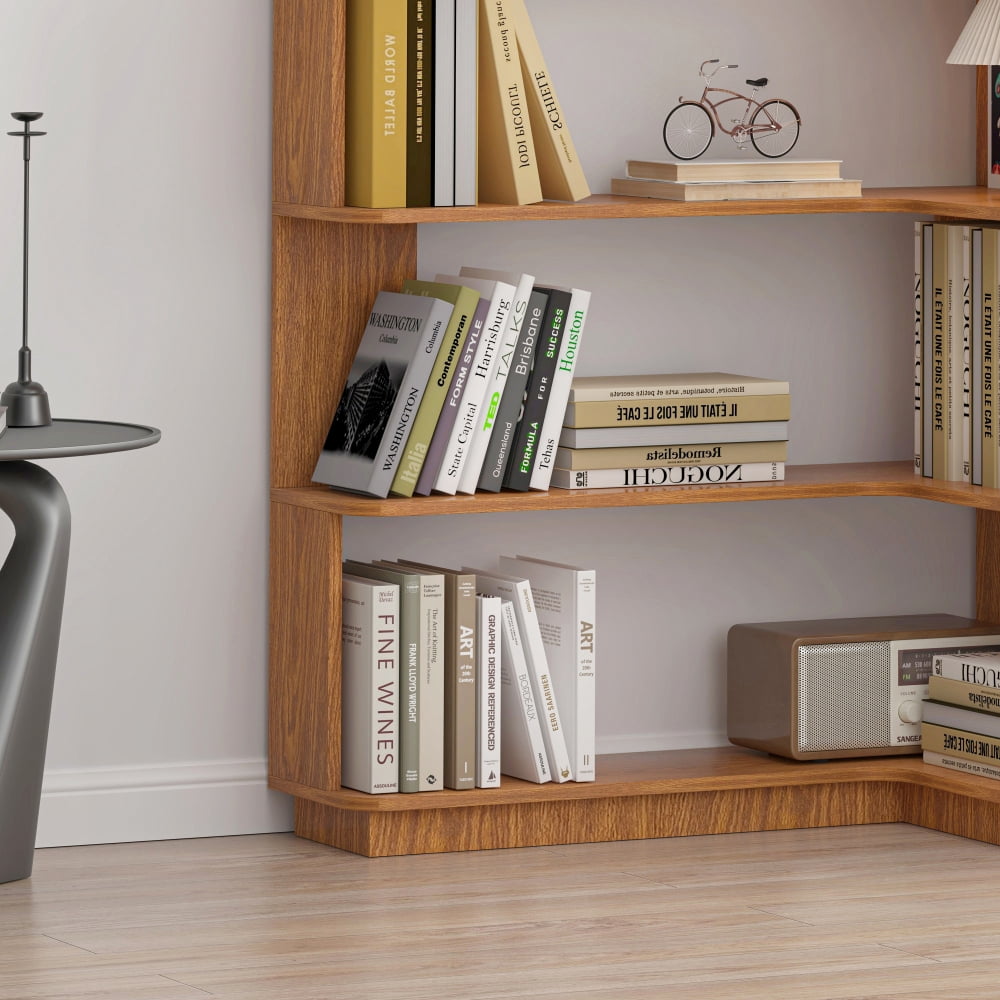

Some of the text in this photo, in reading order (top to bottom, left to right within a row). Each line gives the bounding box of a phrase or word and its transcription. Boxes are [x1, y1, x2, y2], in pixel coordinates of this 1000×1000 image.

[369, 312, 423, 333] WASHINGTON
[935, 288, 943, 298] IL
[449, 319, 483, 407] FORM STYLE
[483, 300, 527, 432] TED TALKS
[935, 335, 943, 356] UNE
[935, 360, 943, 382] FOIS
[382, 320, 442, 472] WASHINGTON Columbia
[400, 314, 468, 484] Italia Contemporan
[448, 298, 511, 478] State Capital Harrisburg
[492, 307, 542, 479] Queensland Brisbane
[519, 308, 564, 474] FORMULA FOR SUCCESS
[539, 310, 584, 470] Tehas Houston
[935, 387, 943, 399] LE
[935, 404, 943, 431] CAFÉ
[377, 614, 395, 670] FINE
[459, 625, 474, 659] ART
[580, 621, 593, 653] ART
[408, 643, 417, 723] FRANK LLOYD WRIGHT
[487, 614, 496, 751] GRAPHIC DESIGN REFERENCED
[518, 673, 536, 721] BORDEAUX
[540, 674, 559, 732] EERO SAARINEN
[377, 681, 395, 766] WINES
